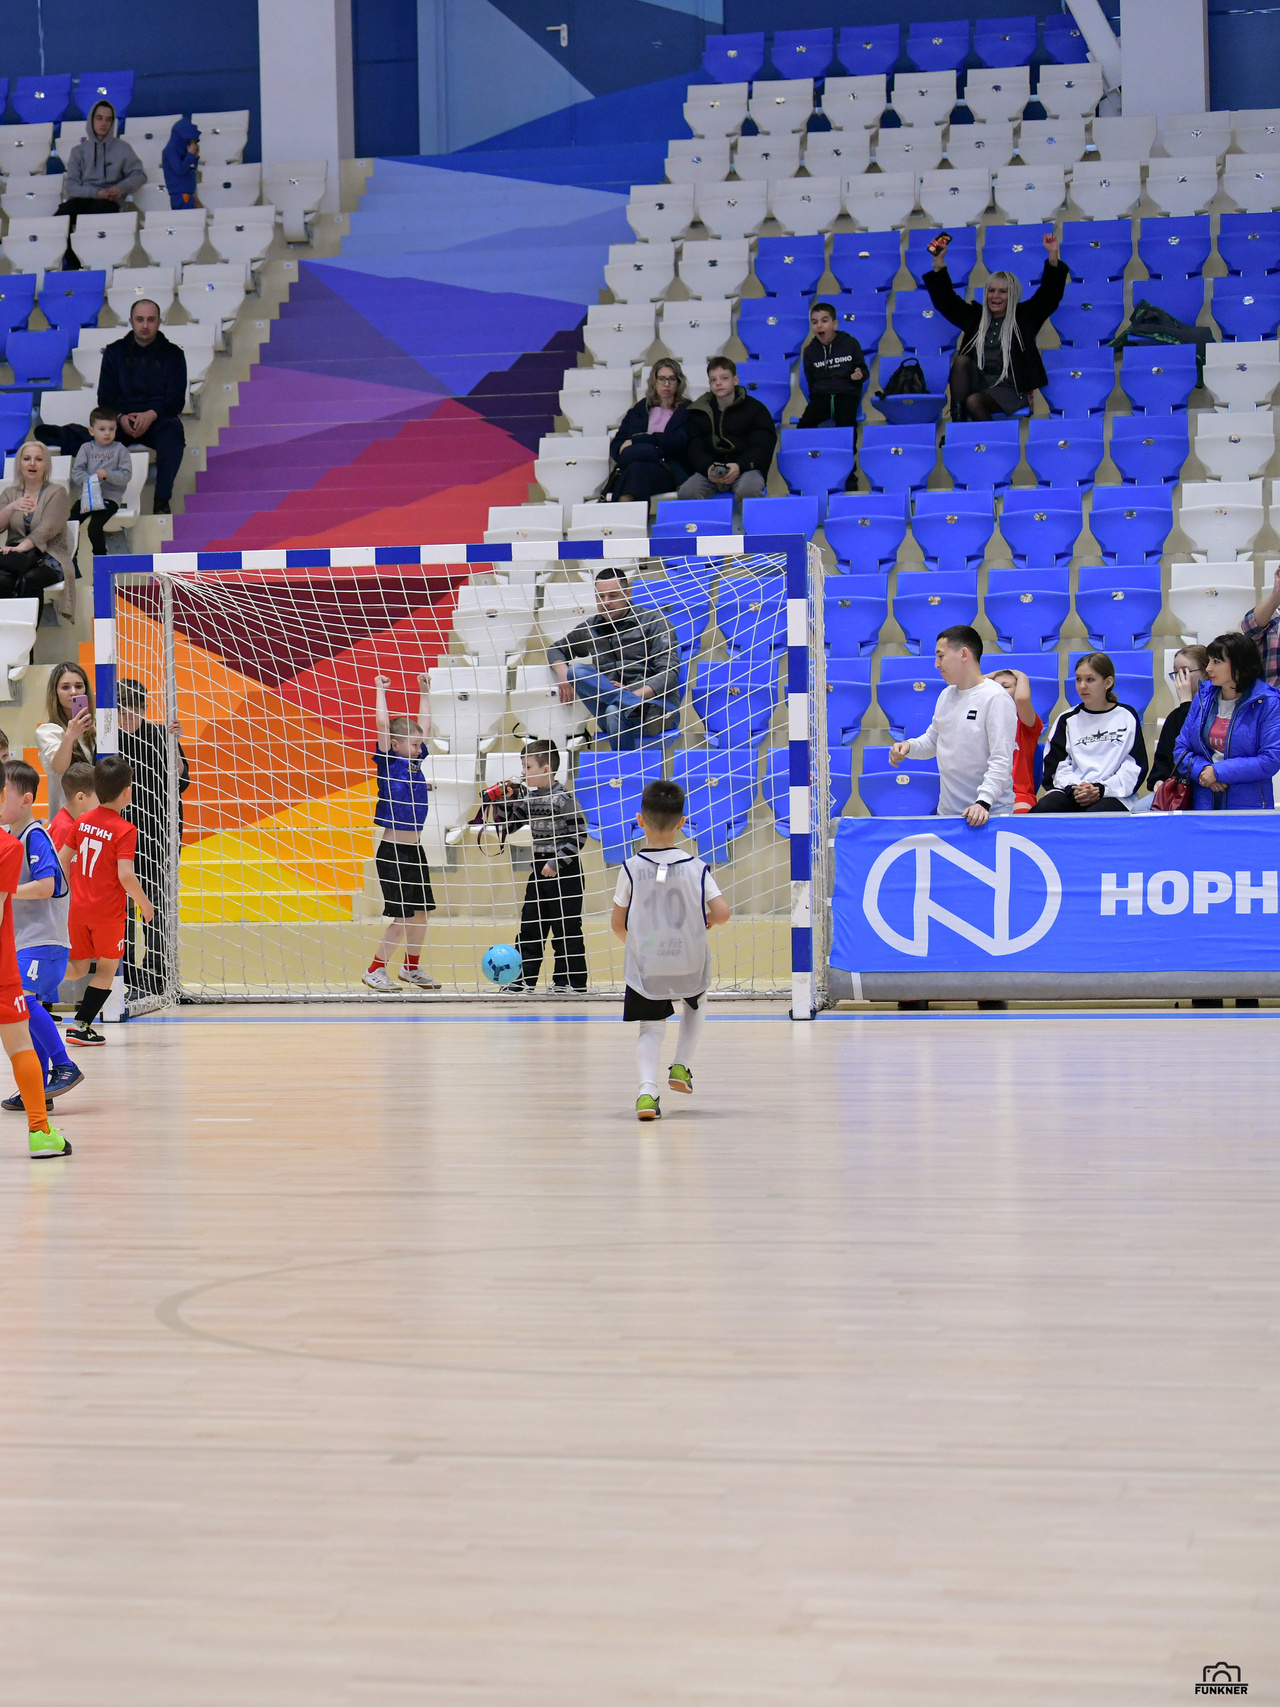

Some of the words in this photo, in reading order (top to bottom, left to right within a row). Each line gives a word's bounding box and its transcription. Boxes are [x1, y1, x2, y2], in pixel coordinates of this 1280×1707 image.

[79, 822, 113, 841] ЛЯГИН
[79, 836, 103, 878] 17
[637, 864, 685, 882] ЛЫИН
[1100, 870, 1279, 915] НОРН
[642, 887, 687, 931] 10
[27, 959, 39, 981] 4
[14, 994, 27, 1013] 17
